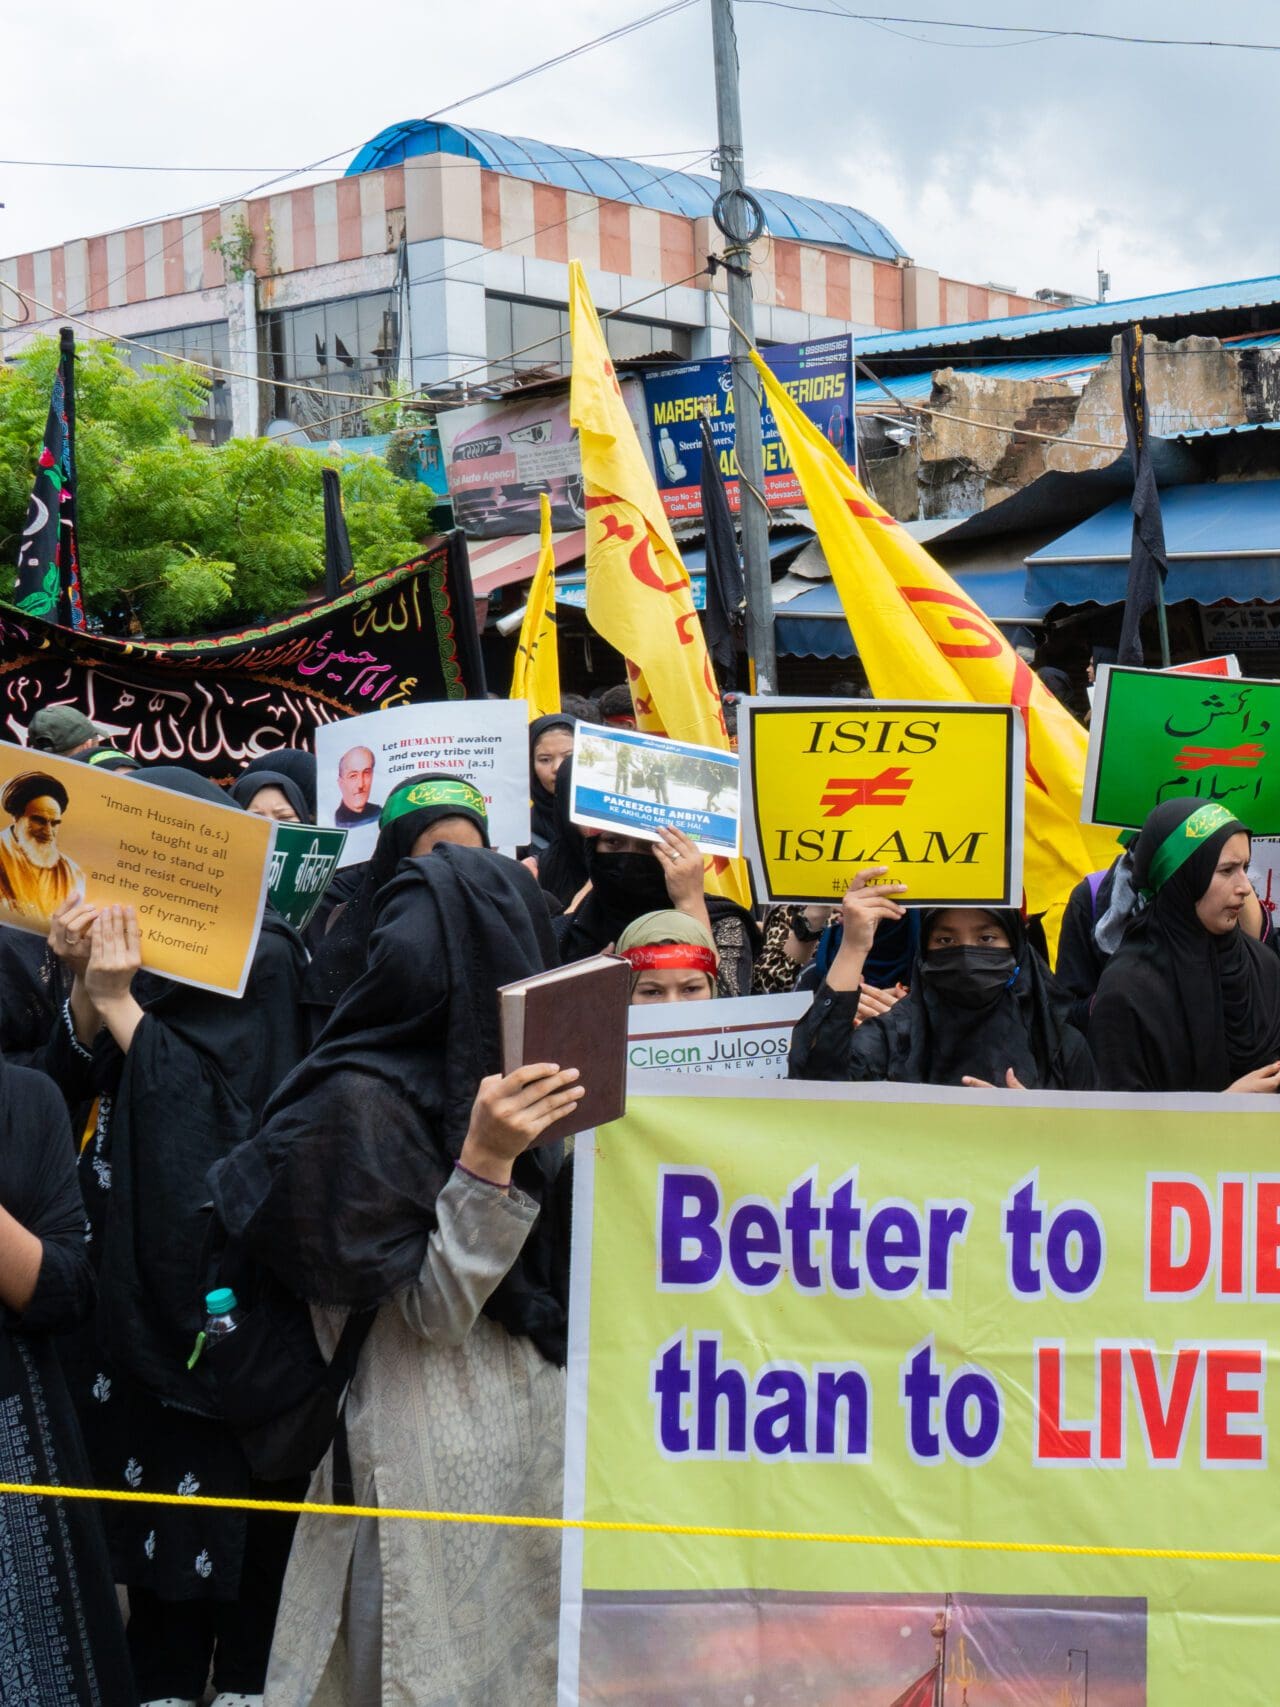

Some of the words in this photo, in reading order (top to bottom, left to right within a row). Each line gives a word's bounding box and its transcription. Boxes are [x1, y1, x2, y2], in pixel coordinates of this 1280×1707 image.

[766, 373, 846, 408] TERIORS
[663, 494, 679, 503] Shop
[382, 742, 397, 751] Let
[400, 736, 455, 748] HUMANITY
[457, 735, 502, 744] awaken
[802, 720, 941, 754] ISIS
[388, 751, 408, 761] and
[411, 749, 440, 759] every
[444, 747, 471, 756] tribe
[474, 747, 494, 755] will
[388, 763, 415, 773] claim
[418, 759, 464, 769] HUSSAIN
[468, 759, 494, 769] (a.s.)
[603, 796, 666, 816] PAKEEZGEE
[669, 808, 711, 824] ANBIYA
[609, 805, 619, 813] KE
[621, 808, 651, 822] AKHLAQ
[654, 815, 674, 826] MEIN
[676, 819, 686, 828] SE
[147, 808, 195, 832] Hussain
[200, 824, 230, 844] (a.s.)
[120, 840, 149, 856] how
[153, 850, 166, 861] to
[170, 853, 204, 872] stand
[208, 867, 224, 879] up
[151, 830, 191, 850] taught
[195, 845, 208, 855] us
[212, 848, 227, 860] all
[773, 829, 989, 864] ISLAM
[91, 870, 115, 885] and
[119, 878, 139, 891] the
[142, 885, 219, 914] government
[117, 858, 141, 873] and
[145, 867, 175, 883] resist
[180, 876, 222, 898] cruelty
[140, 904, 153, 914] of
[147, 928, 209, 956] Khomeini
[629, 1045, 701, 1067] Clean
[707, 1037, 788, 1061] Juloos
[725, 1059, 755, 1070] NEW
[660, 1172, 968, 1294] Better
[1005, 1179, 1102, 1294] to
[654, 1338, 867, 1456] than
[904, 1344, 999, 1458] to
[1037, 1346, 1263, 1460] LIVE
